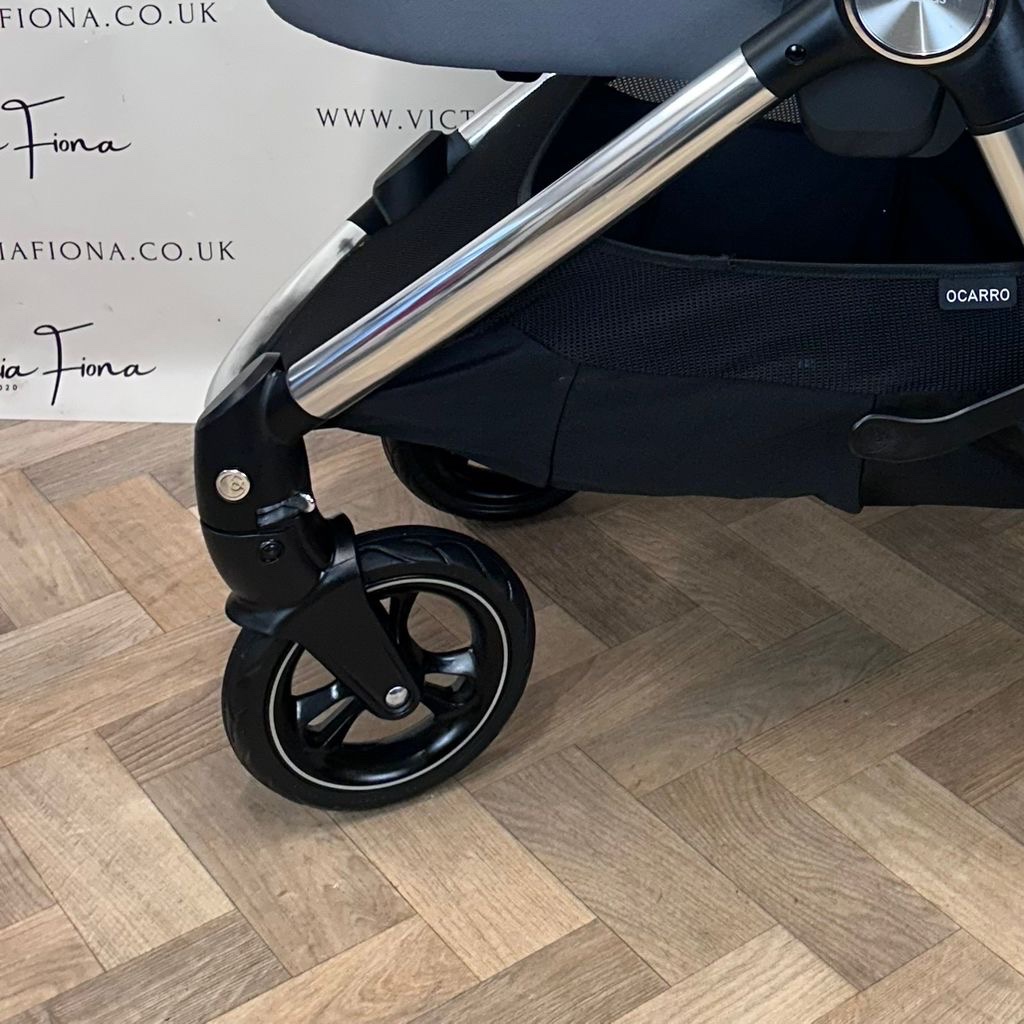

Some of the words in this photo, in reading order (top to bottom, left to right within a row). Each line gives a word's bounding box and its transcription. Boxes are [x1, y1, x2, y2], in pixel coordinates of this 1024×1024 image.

[2, 96, 132, 179] Fiona
[946, 288, 1010, 303] OCARRO
[34, 322, 157, 407] Fiona
